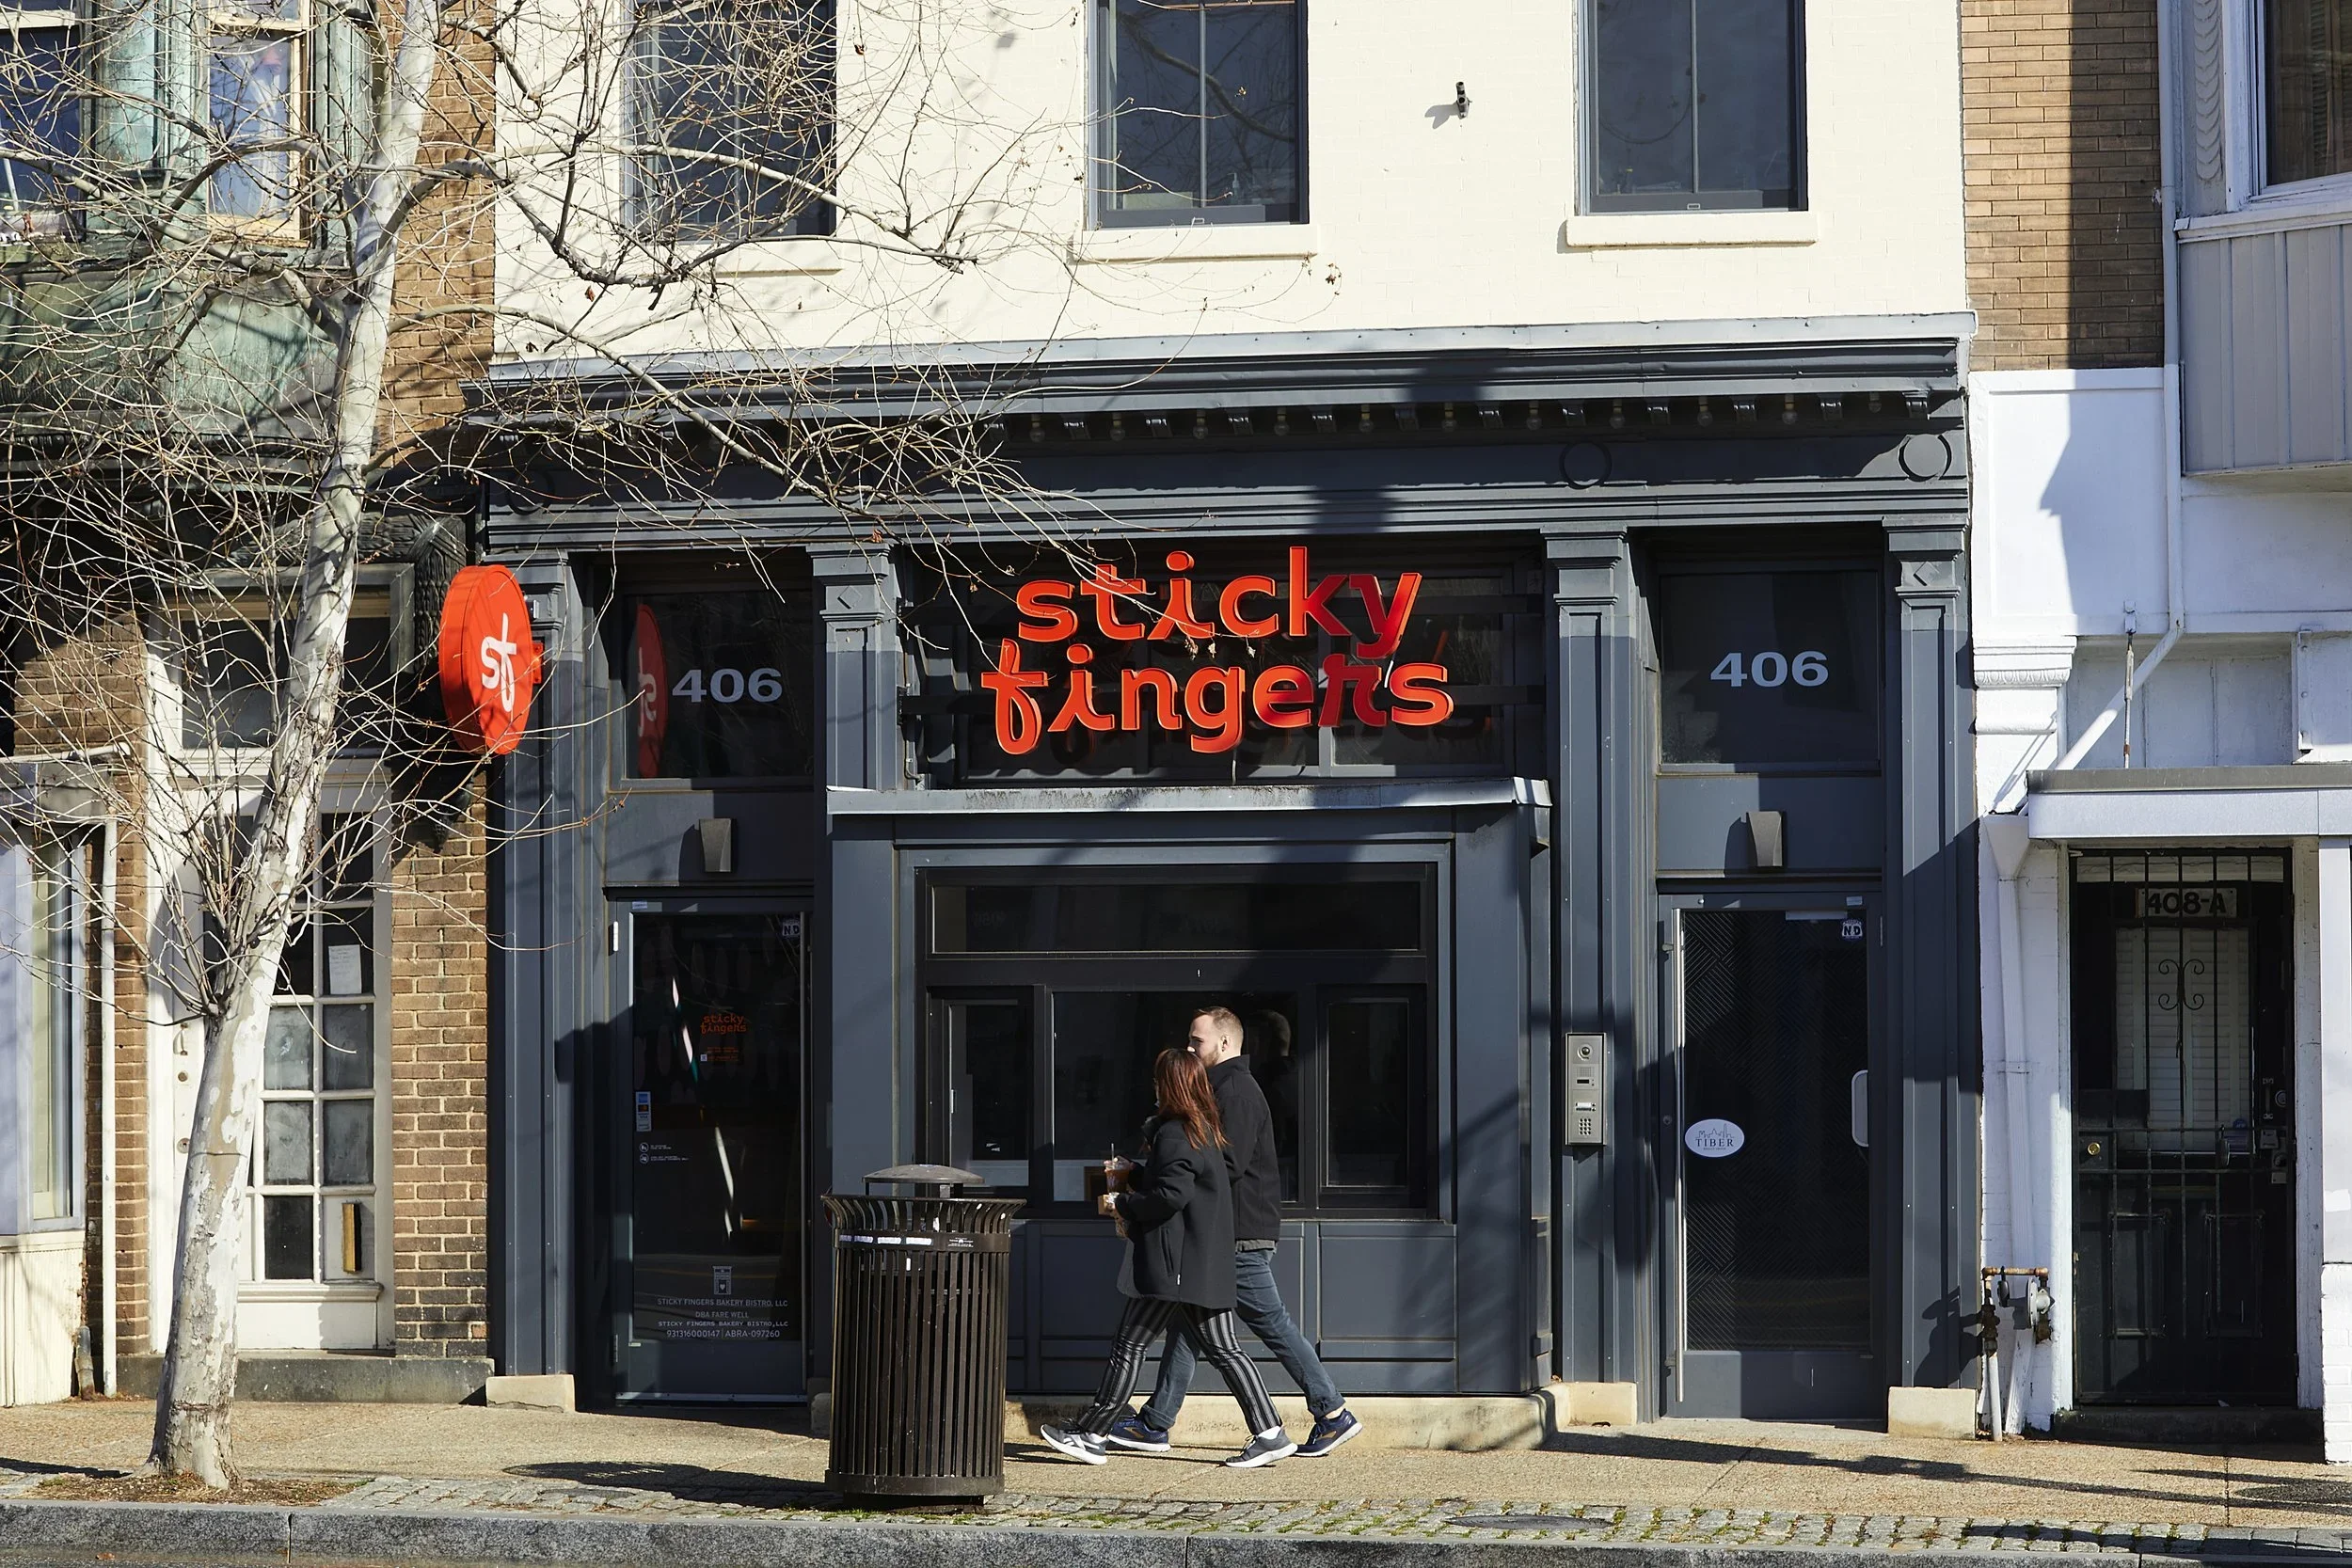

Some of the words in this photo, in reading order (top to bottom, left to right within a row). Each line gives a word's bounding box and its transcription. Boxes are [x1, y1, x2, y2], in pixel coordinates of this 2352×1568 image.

[1016, 546, 1423, 658] sticky
[1710, 650, 1829, 688] 406
[672, 668, 783, 704] 406
[980, 638, 1454, 755] fingers
[2147, 892, 2227, 915] 408-A
[700, 1022, 747, 1036] fingers
[702, 1013, 744, 1025] sticky
[1695, 1138, 1734, 1148] TIBER
[684, 1298, 714, 1307] FINGERS
